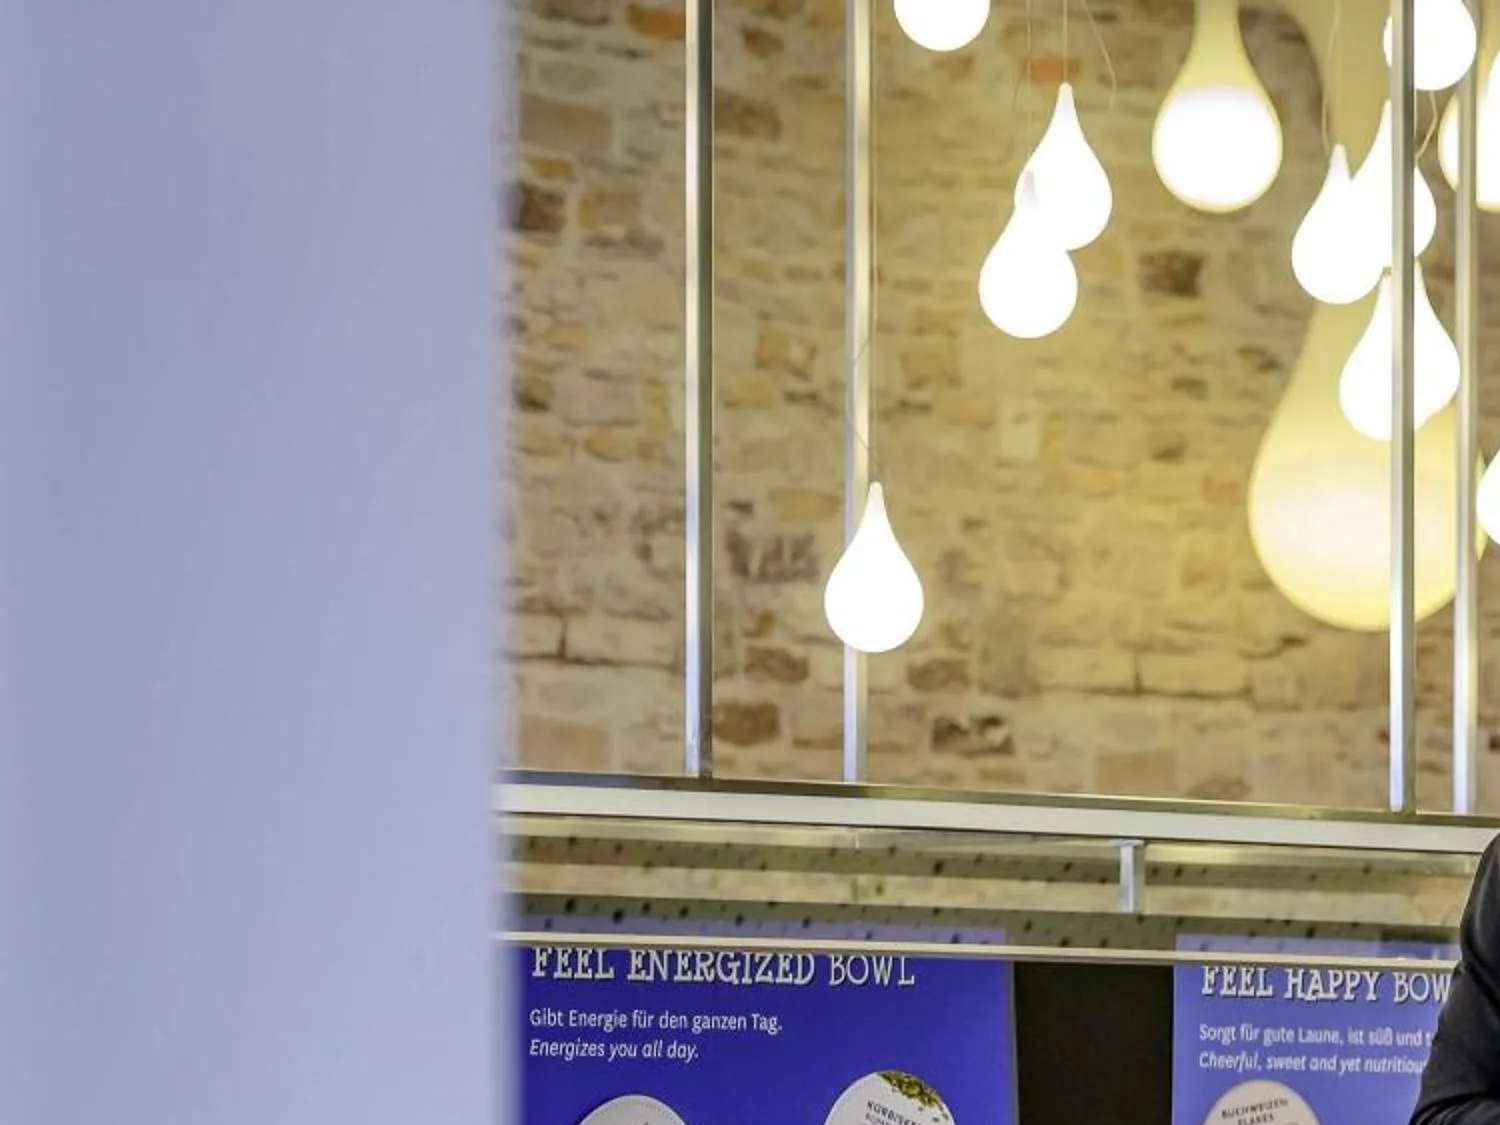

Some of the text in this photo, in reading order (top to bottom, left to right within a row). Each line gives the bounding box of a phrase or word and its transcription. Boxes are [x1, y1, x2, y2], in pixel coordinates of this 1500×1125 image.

[531, 946, 916, 987] FEEL ENERGIZED BOWL
[1201, 965, 1452, 1004] FEEL HAPPY BOW
[529, 1008, 783, 1036] Gibt Energie für den ganzen Tag.
[1199, 1023, 1238, 1046] Sorgt
[1240, 1022, 1260, 1042] für
[1262, 1026, 1296, 1048] gute
[1298, 1026, 1345, 1047] Laune,
[1347, 1026, 1365, 1046] ist
[1396, 1029, 1423, 1048] und
[528, 1037, 700, 1064] Energizes you all day.
[1199, 1050, 1425, 1077] Cheerful, sweet and yet nutritiou
